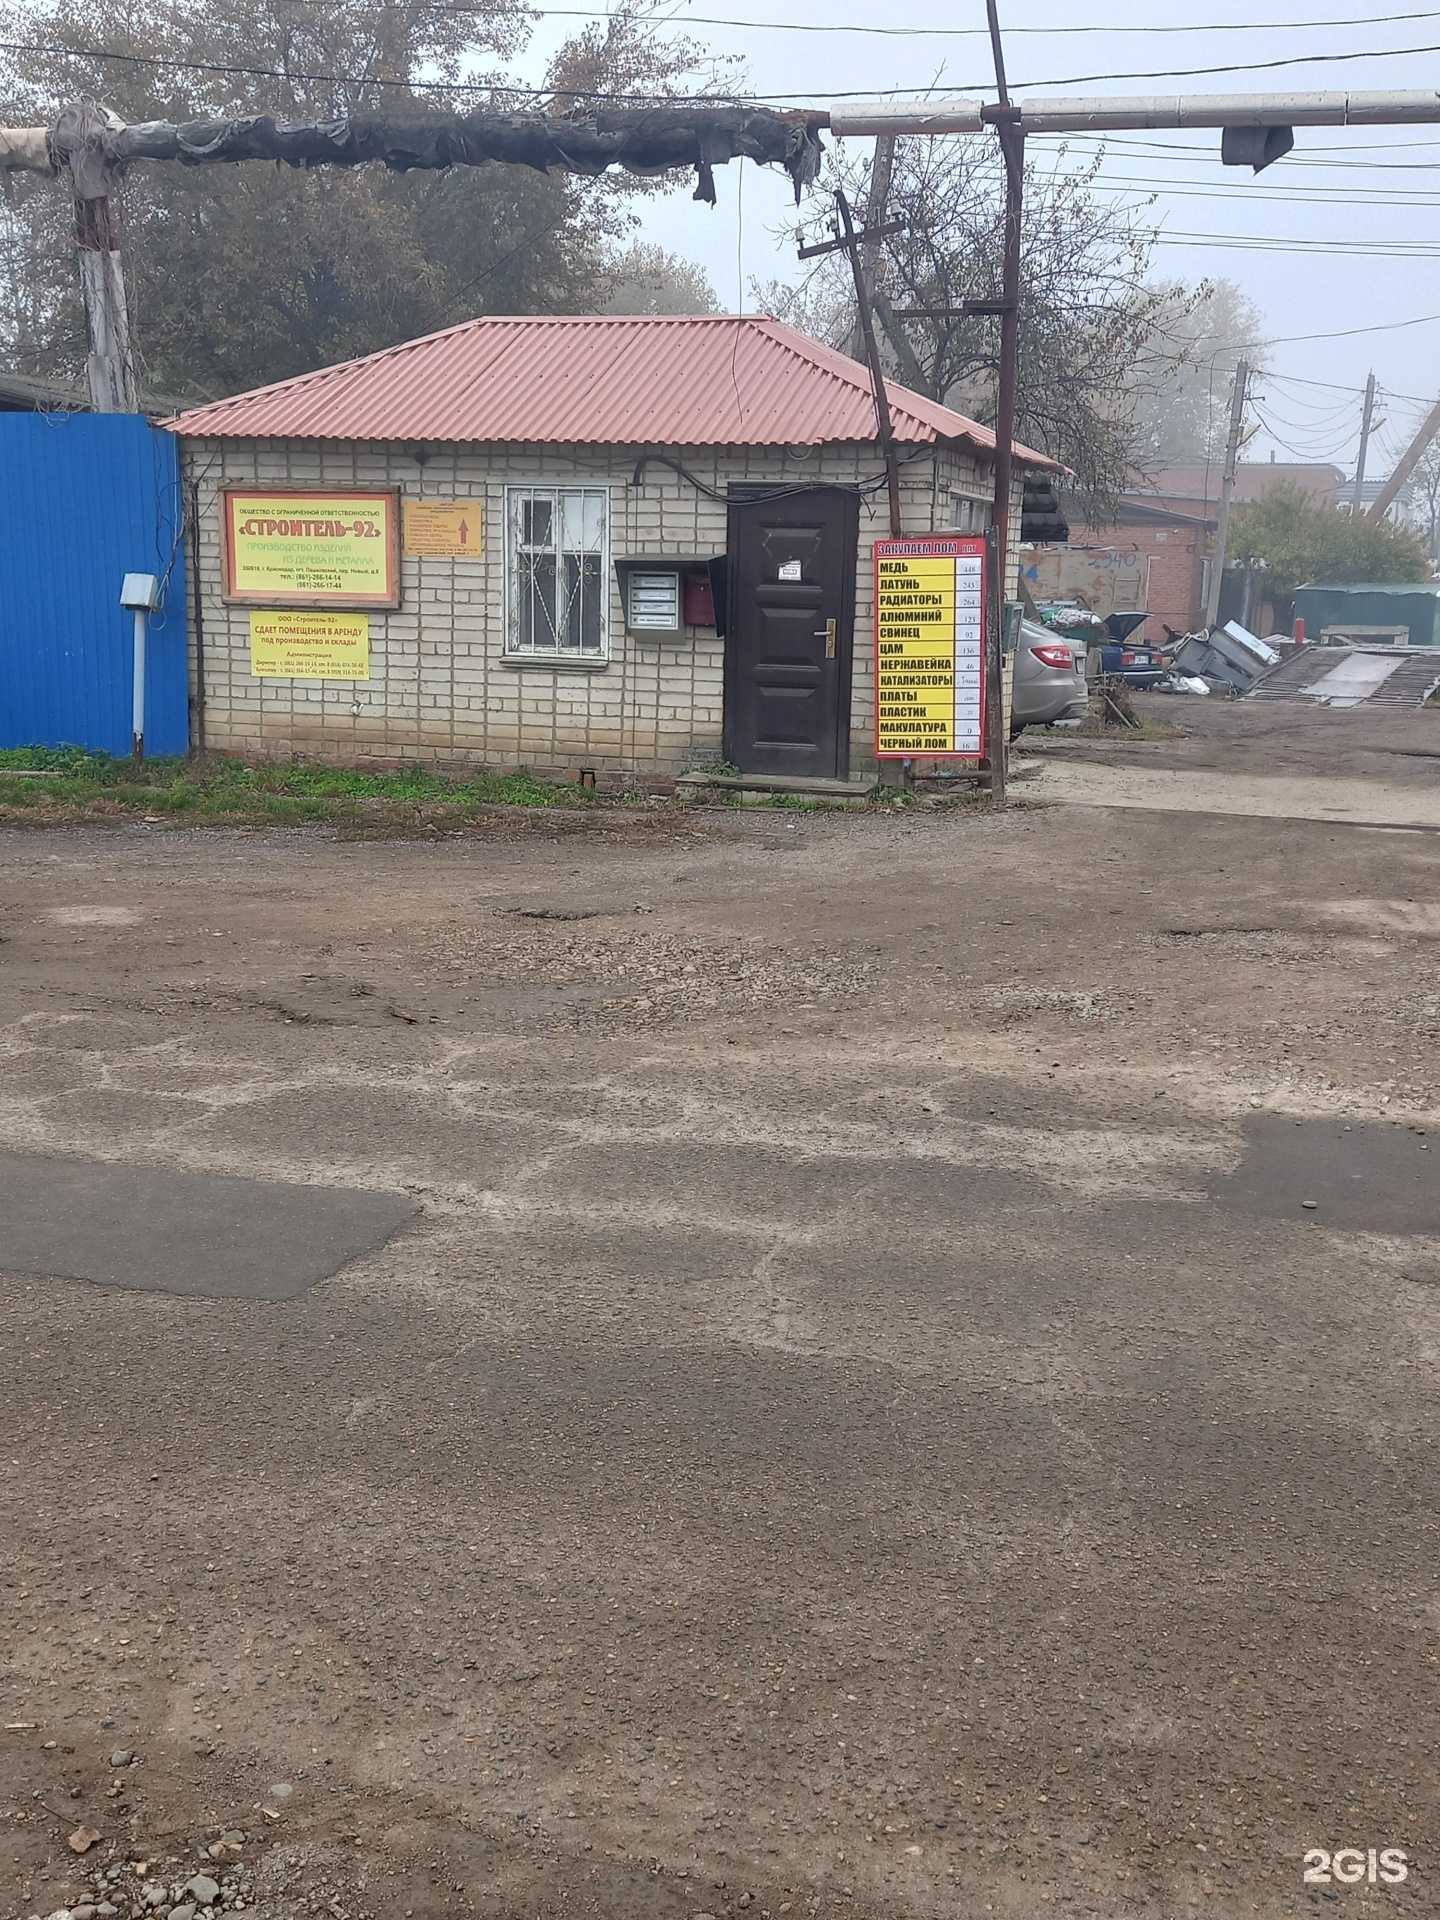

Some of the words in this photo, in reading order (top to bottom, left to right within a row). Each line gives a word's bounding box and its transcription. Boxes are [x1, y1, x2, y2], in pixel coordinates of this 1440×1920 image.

[239, 518, 382, 538] «СТРОИТЕЛЬ-92»
[247, 542, 312, 552] ПРОИЗВОДСТВО
[878, 542, 931, 554] ЗАКУПАЕМ
[933, 541, 957, 554] ЛОМ
[295, 555, 327, 565] ДЕРЕВА
[880, 562, 908, 574] МЕДЬ
[880, 579, 919, 590] ЛАТУНЬ
[880, 594, 942, 607] РАДИАТОРЫ
[880, 609, 942, 622] АЛЮМИНИЙ
[255, 626, 276, 635] СДАЕТ
[278, 626, 327, 636] ПОМЕЩЕНИЯ
[334, 628, 363, 637] АРЕНДУ
[880, 628, 920, 639] СВИНЕЦ
[275, 638, 323, 646] производство
[880, 643, 903, 655] ЦАМ
[880, 658, 952, 670] НЕРЖАВЕЙКА
[880, 675, 953, 686] КАТАЛИЗАТОРЫ
[880, 691, 918, 702] ПЛАТЫ
[880, 707, 927, 718] ПЛАСТИК
[880, 722, 947, 733] МАКУЛАТУРА
[880, 737, 922, 749] ЧЕРНЫЙ
[924, 738, 947, 749] ЛОМ
